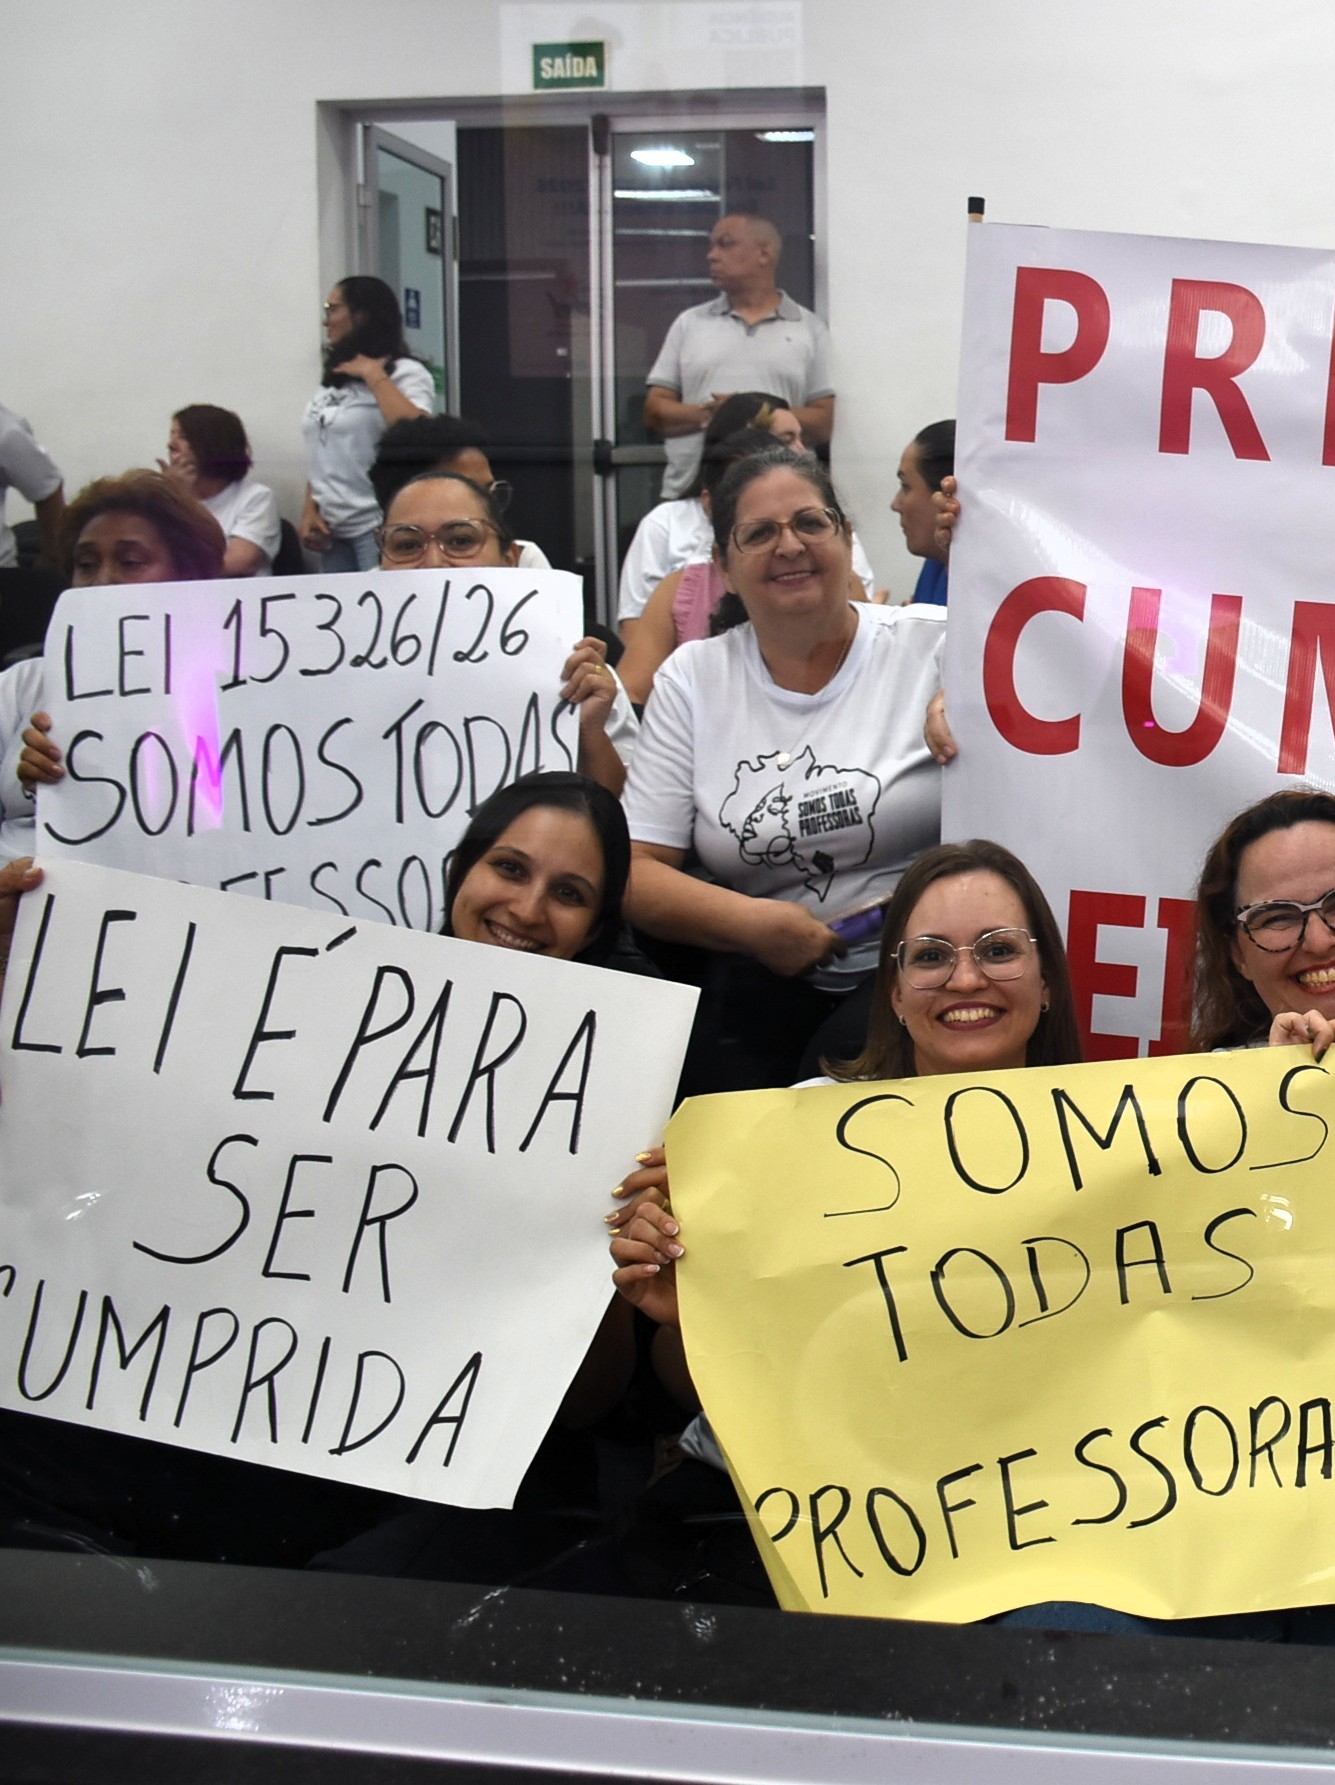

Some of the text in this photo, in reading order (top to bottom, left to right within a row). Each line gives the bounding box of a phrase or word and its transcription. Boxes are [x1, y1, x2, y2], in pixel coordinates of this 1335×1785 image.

[540, 52, 597, 79] SAÍDA
[65, 579, 539, 701] LEI 15326/26
[44, 717, 364, 846] SOMOS
[798, 788, 857, 818] SOMOS TODAS
[798, 806, 863, 837] PROFESSORAS
[11, 893, 197, 1075] LEI
[232, 926, 358, 1101] É
[322, 965, 597, 1155] PARA
[1065, 889, 1200, 1062] EI
[823, 1064, 1331, 1218] SOMOS
[132, 1133, 419, 1304] SER
[842, 1207, 1258, 1363] TODAS
[0, 1264, 483, 1467] UMPRIDA
